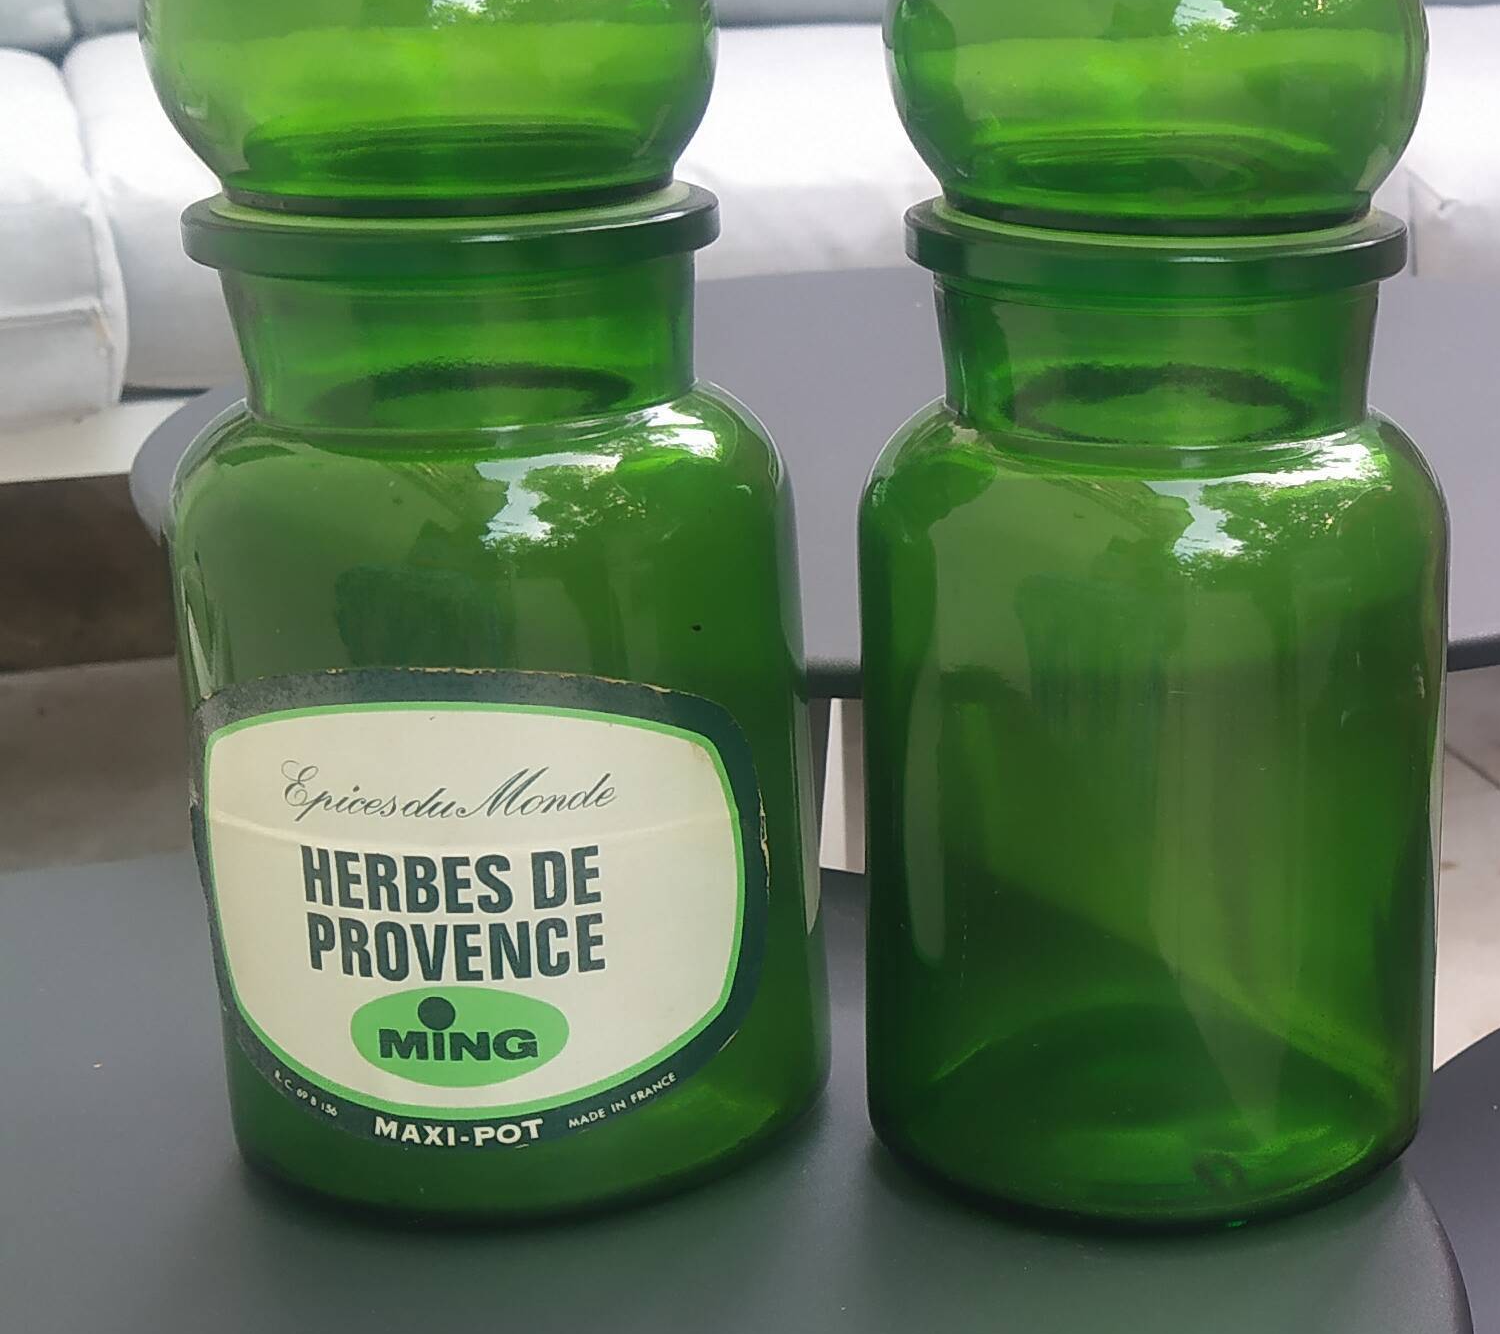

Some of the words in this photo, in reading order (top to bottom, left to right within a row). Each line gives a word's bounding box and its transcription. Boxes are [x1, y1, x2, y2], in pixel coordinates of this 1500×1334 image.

[455, 767, 617, 818] Monde
[300, 844, 513, 913] HERBES
[531, 845, 602, 909] DE
[307, 912, 606, 981] PROVENCE
[568, 1108, 606, 1128] MADE
[610, 1100, 626, 1113] IN
[630, 1072, 677, 1104] FRANCE
[374, 1116, 544, 1147] MAXI-POT
